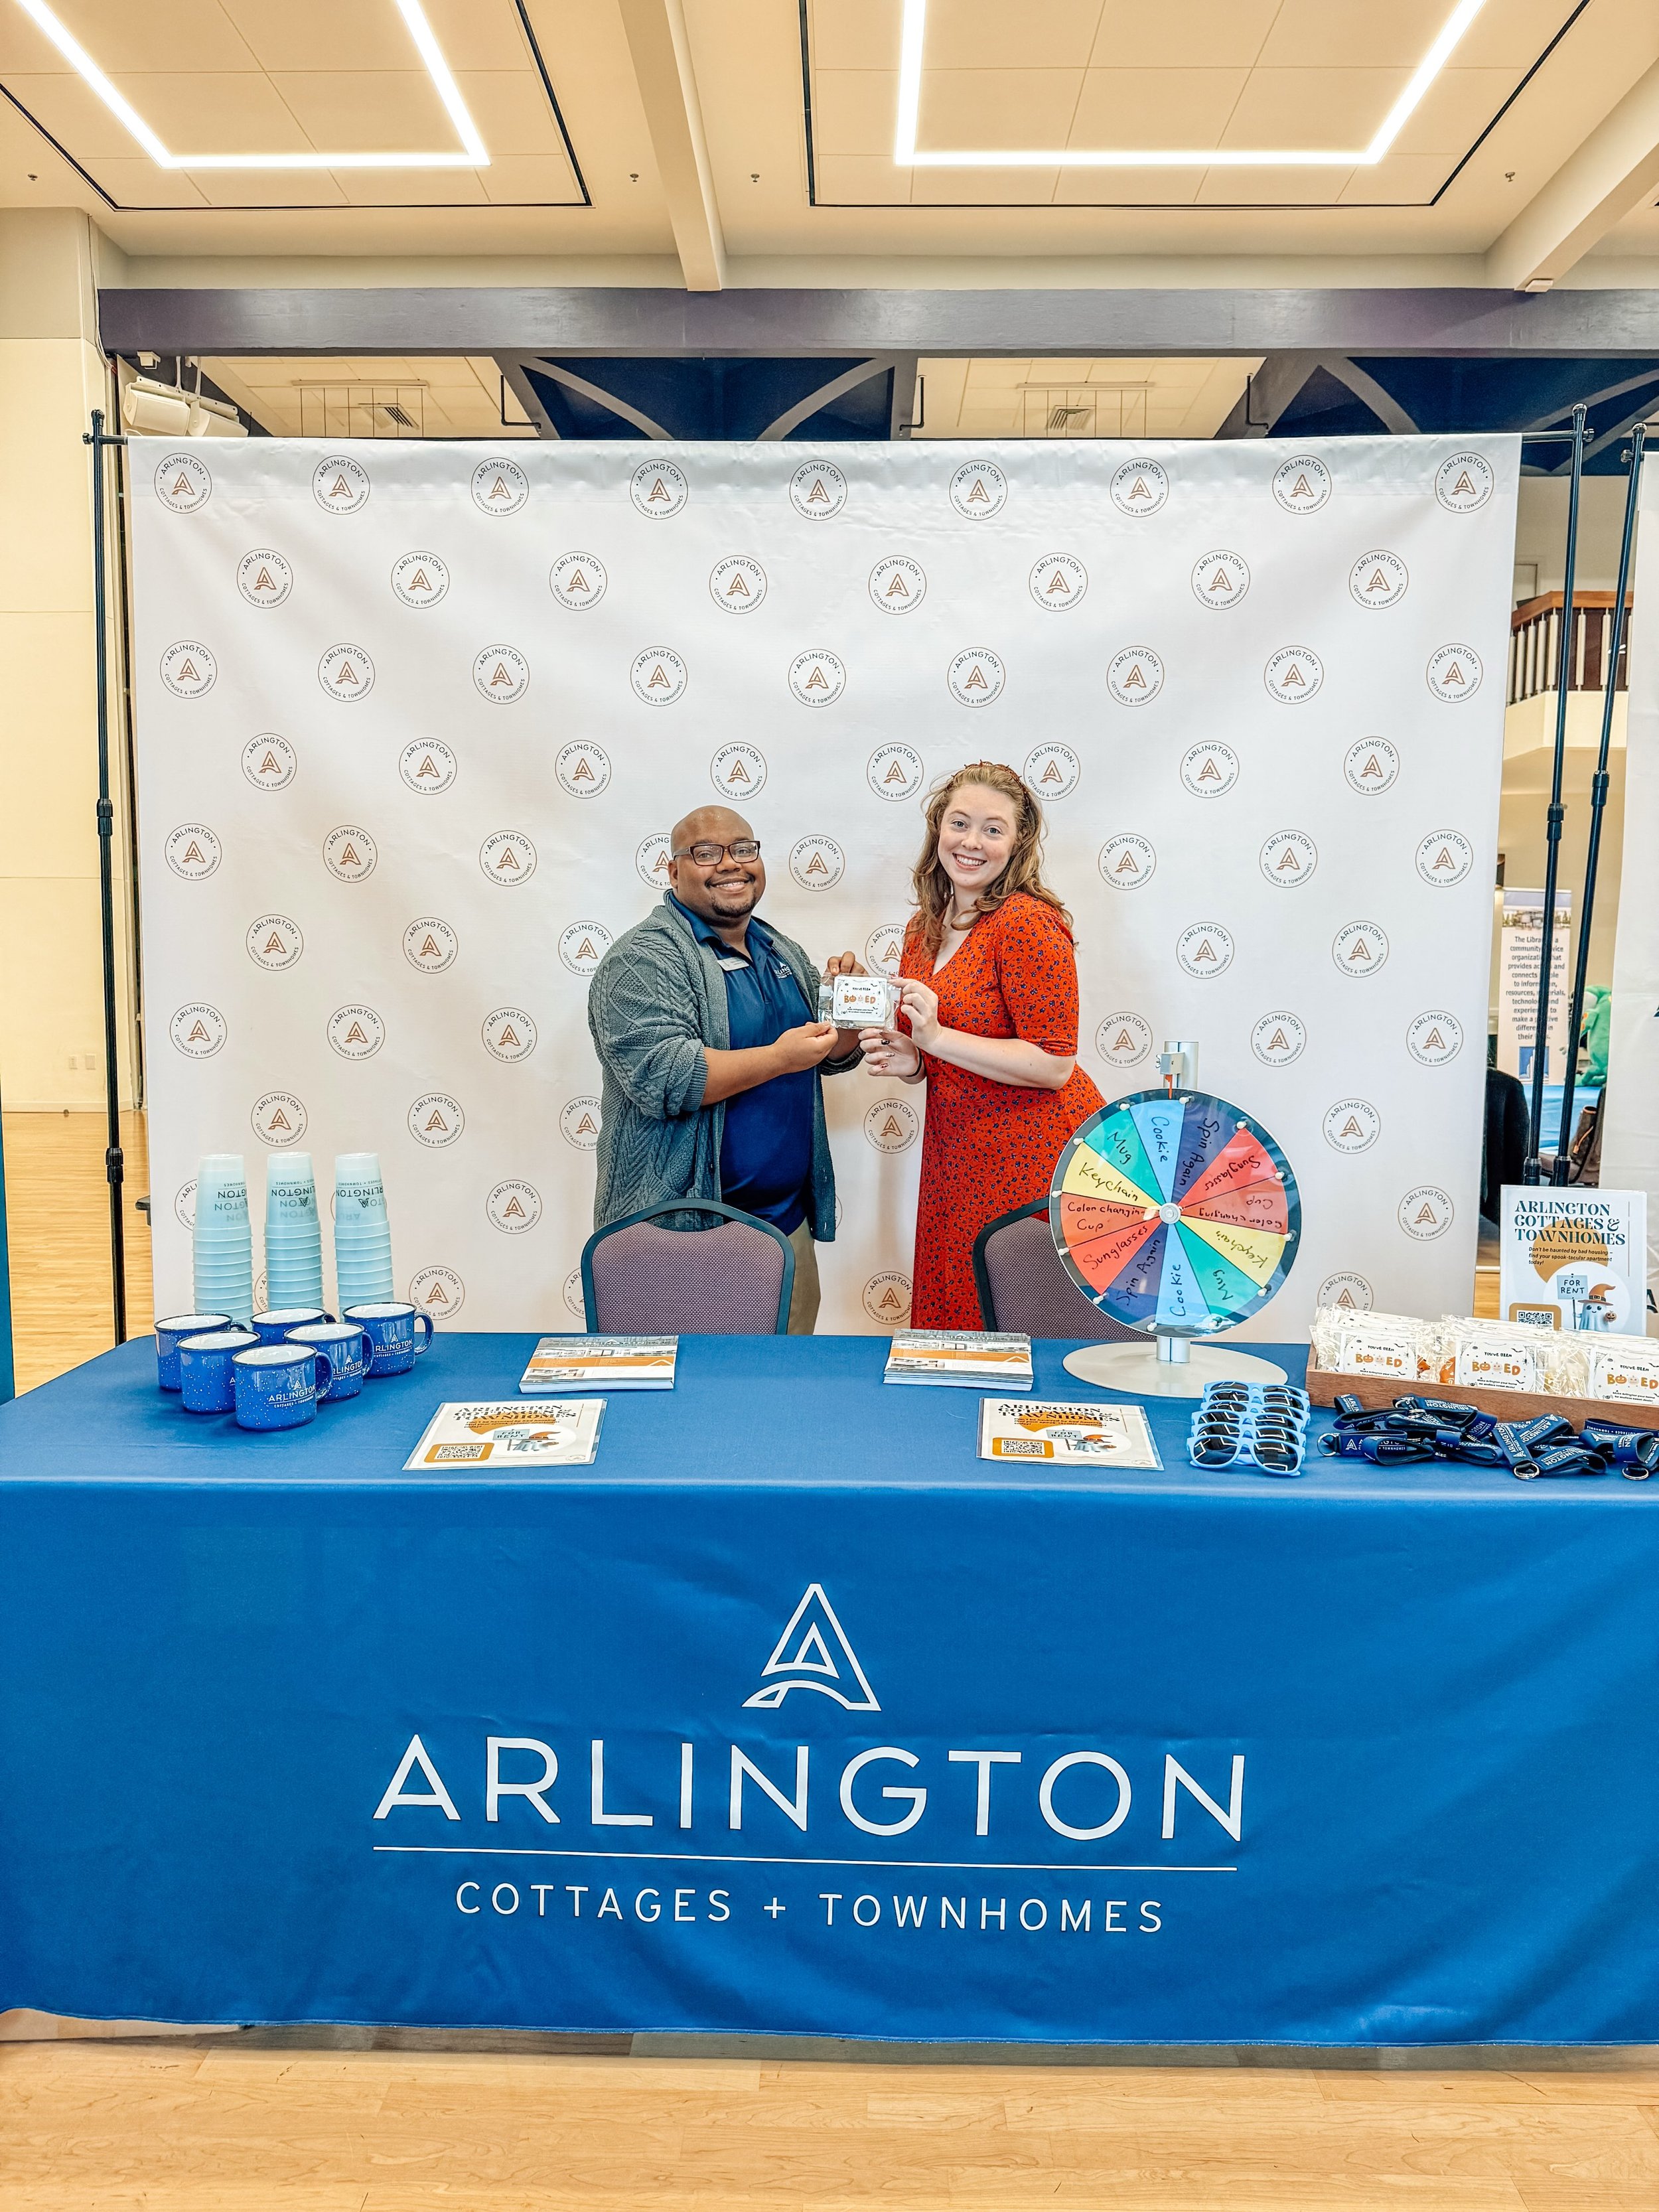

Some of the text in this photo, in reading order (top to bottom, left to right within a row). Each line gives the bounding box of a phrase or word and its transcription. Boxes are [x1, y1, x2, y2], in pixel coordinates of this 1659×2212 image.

[161, 457, 204, 475] ARLINGTON
[478, 462, 522, 479] ARLINGTON
[797, 464, 841, 482] ARLINGTON
[1119, 462, 1163, 479] ARLINGTON
[1443, 456, 1488, 475] ARLINGTON
[160, 488, 177, 508] COTTAGES
[184, 488, 207, 509] TOWNHOMES
[794, 495, 812, 515] COTTAGES
[819, 496, 842, 516] TOWNHOMES
[1439, 488, 1457, 508] COTTAGES
[1464, 487, 1488, 509] TOWNHOMES
[244, 553, 286, 570] ARLINGTON
[877, 559, 920, 577] ARLINGTON
[1199, 554, 1244, 571] ARLINGTON
[326, 648, 368, 664] ARLINGTON
[638, 650, 680, 668] ARLINGTON
[956, 651, 999, 669] ARLINGTON
[1273, 650, 1317, 667] ARLINGTON
[323, 677, 341, 696] COTTAGES
[348, 678, 370, 698] TOWNHOMES
[1269, 680, 1287, 700] COTTAGES
[1294, 679, 1319, 700] TOWNHOMES
[249, 737, 290, 754] ARLINGTON
[1352, 741, 1394, 757] ARLINGTON
[487, 834, 530, 850] ARLINGTON
[796, 839, 838, 855] ARLINGTON
[1106, 838, 1149, 854] ARLINGTON
[484, 861, 502, 881] COTTAGES
[509, 863, 532, 882] TOWNHOMES
[177, 1007, 220, 1023] ARLINGTON
[871, 1102, 912, 1118] ARLINGTON
[1331, 1102, 1374, 1118] ARLINGTON
[1151, 1116, 1170, 1162] Cookie
[1328, 1130, 1345, 1149] COTTAGES
[1352, 1131, 1376, 1150] TOWNHOMES
[1107, 1132, 1131, 1165] Mug
[1179, 1118, 1220, 1186] Spin Again
[1205, 1155, 1261, 1191] Sunglasses
[336, 1186, 383, 1197] RLINGTON
[1246, 1196, 1273, 1210] Cup
[1514, 1200, 1610, 1216] ARLINGTON
[1200, 1208, 1246, 1222] changing
[1514, 1215, 1620, 1232] COTTAGES &
[1077, 1218, 1104, 1232] Cup
[1515, 1228, 1625, 1246] TOWNHOMES
[1083, 1226, 1148, 1270] Sunglasses
[1137, 1239, 1161, 1274] Again
[1216, 1230, 1268, 1268] Keychain
[416, 1270, 458, 1286] ARLINGTON
[1212, 1270, 1233, 1300] Mug
[375, 1339, 413, 1352] RLINGTON
[374, 1735, 1244, 1841] ARLINGTON
[457, 1882, 1161, 1932] COTTAGES + TOWNHOMES
